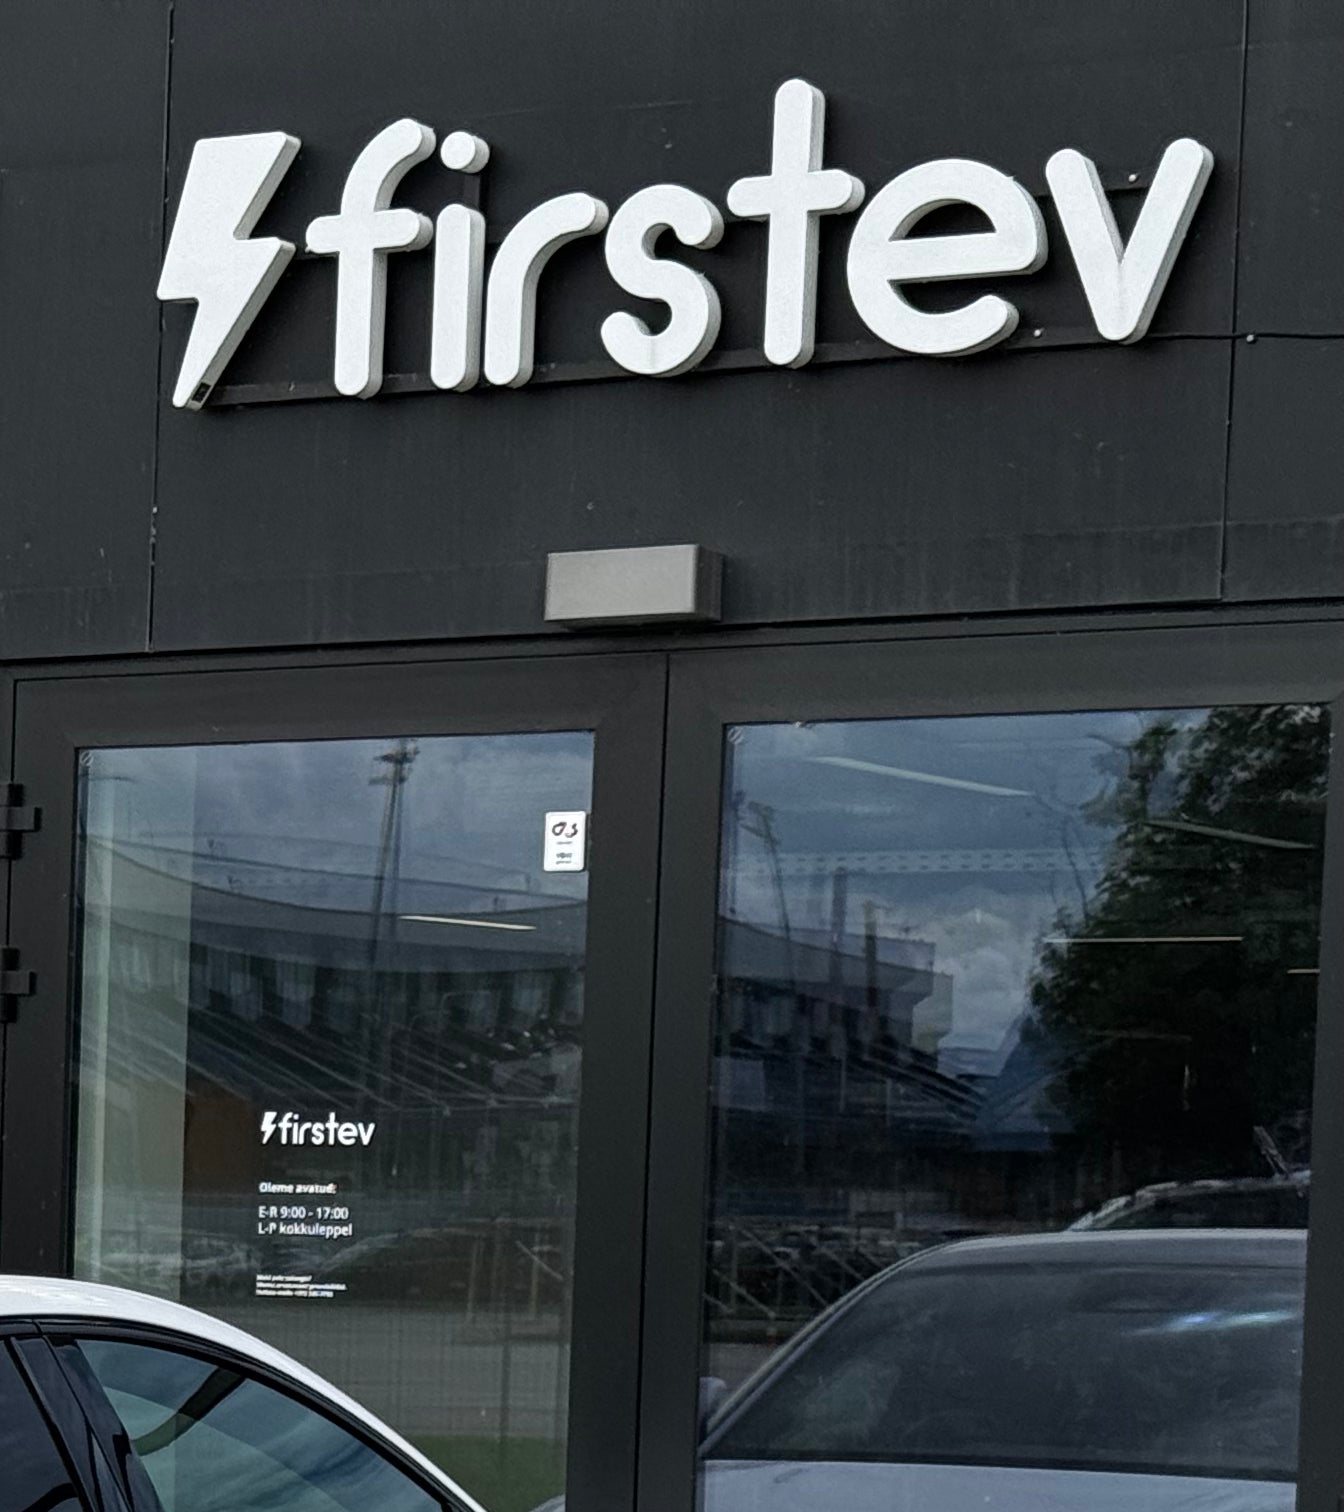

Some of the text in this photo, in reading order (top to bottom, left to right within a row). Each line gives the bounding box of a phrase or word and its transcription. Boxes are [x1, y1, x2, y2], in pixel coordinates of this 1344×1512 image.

[305, 78, 1215, 399] firstev
[277, 1112, 376, 1146] firstev
[280, 1206, 306, 1219] 9:00
[316, 1206, 349, 1220] 17:00
[279, 1222, 353, 1240] kokkuleppel
